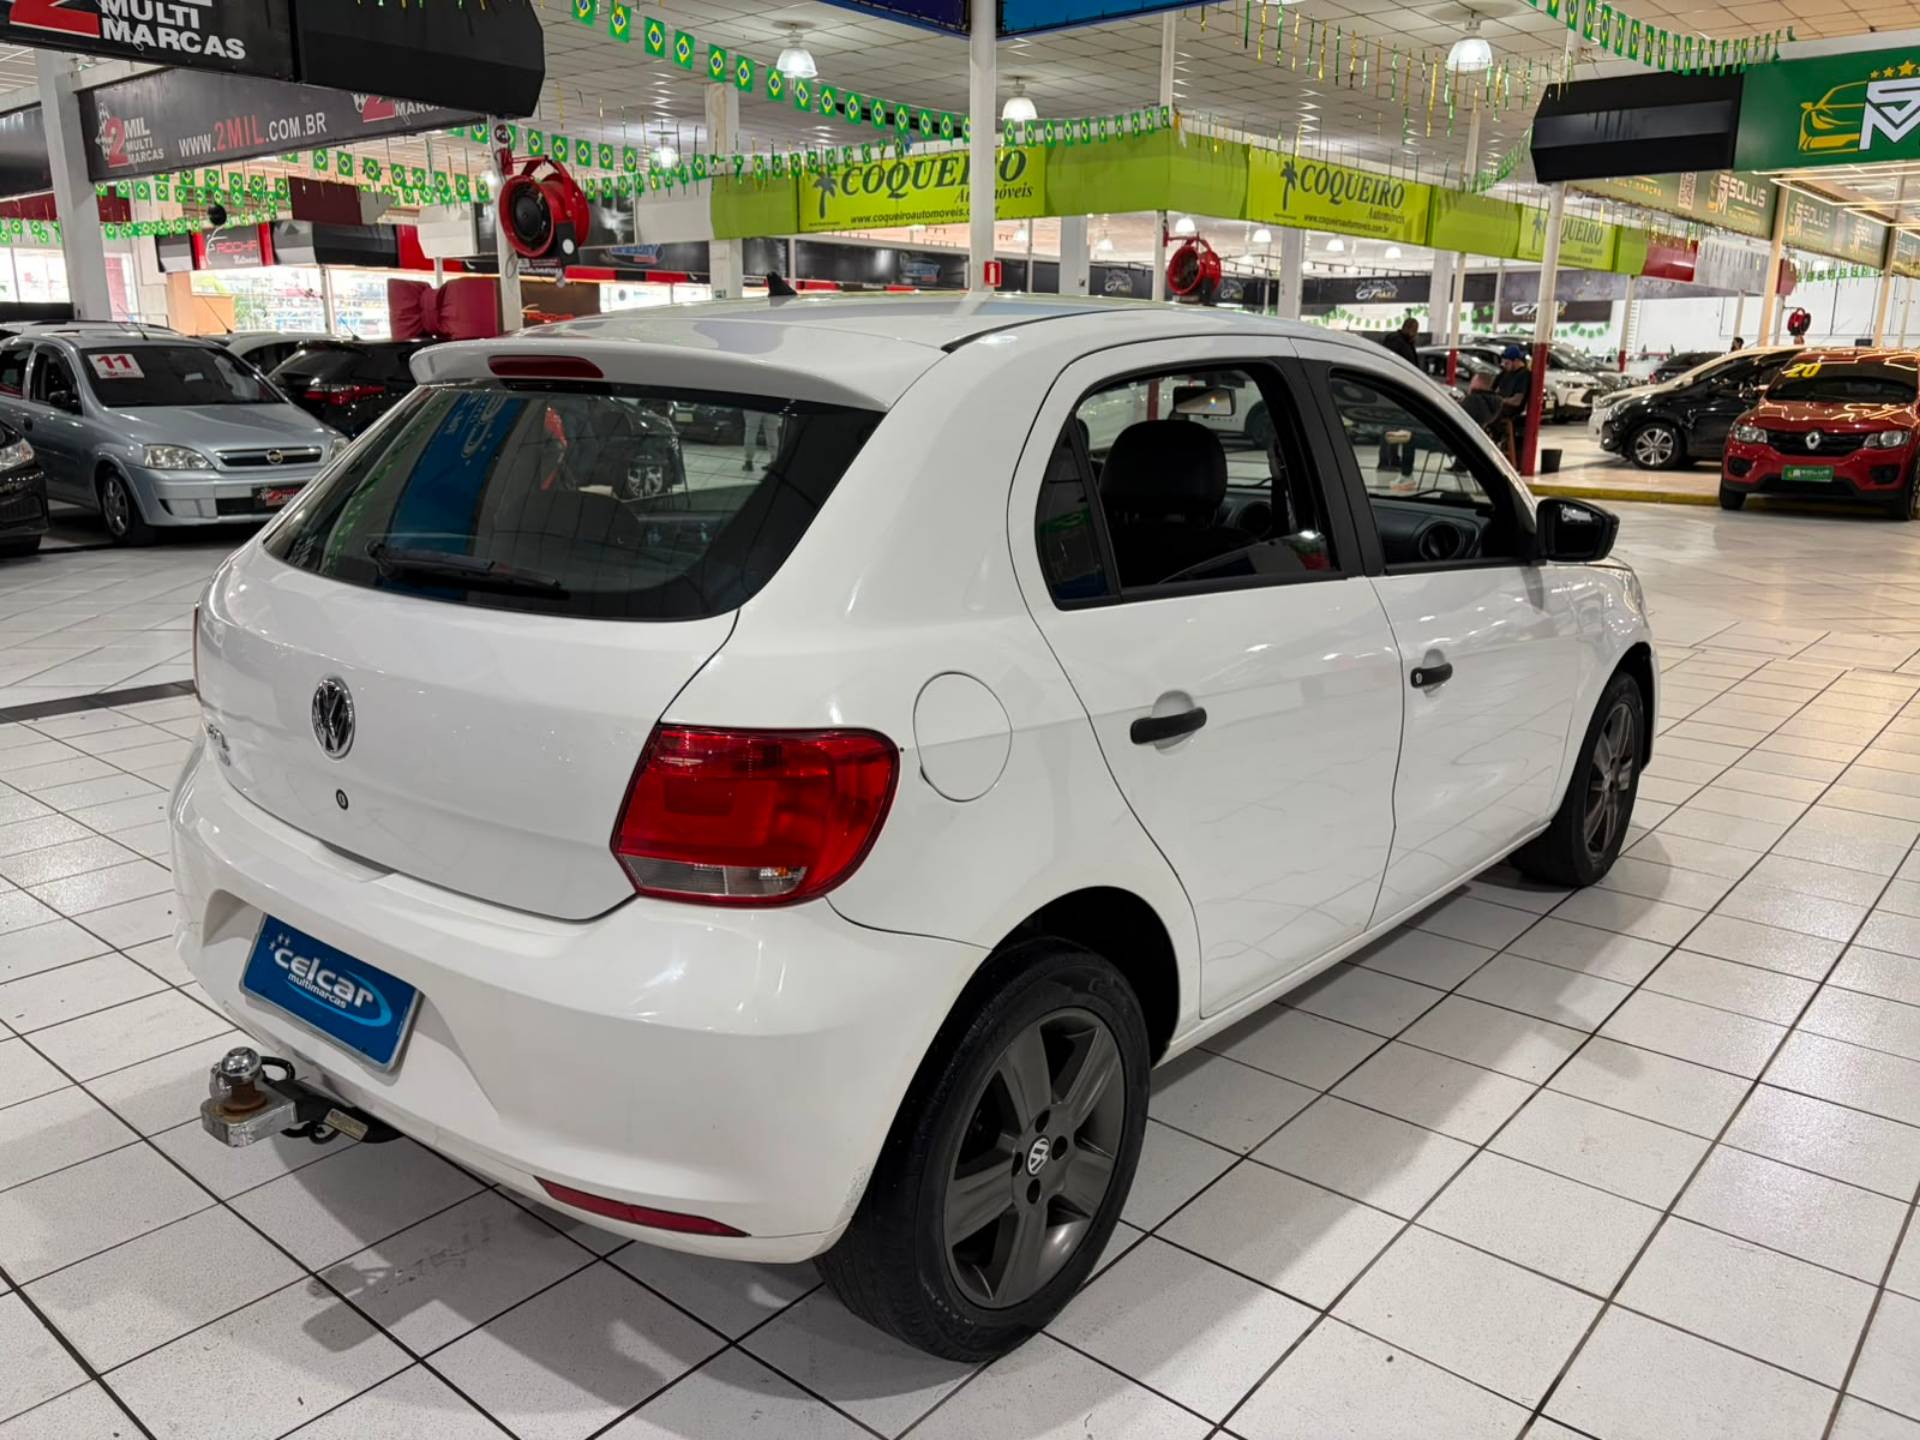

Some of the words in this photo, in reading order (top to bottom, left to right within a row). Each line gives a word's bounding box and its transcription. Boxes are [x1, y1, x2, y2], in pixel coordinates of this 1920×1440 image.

[98, 0, 200, 29] MULTI
[102, 18, 246, 60] MARCAS
[126, 136, 153, 153] MULTI
[178, 112, 328, 158] WWW.2MIL.COM.BR
[127, 147, 165, 165] MARCAS
[841, 149, 1027, 199] COQUEIO
[1300, 165, 1405, 209] COQUEIRO
[97, 355, 132, 369] 11
[1784, 362, 1821, 378] 20
[274, 947, 374, 1008] celcar
[287, 972, 347, 1009] multimarcas
